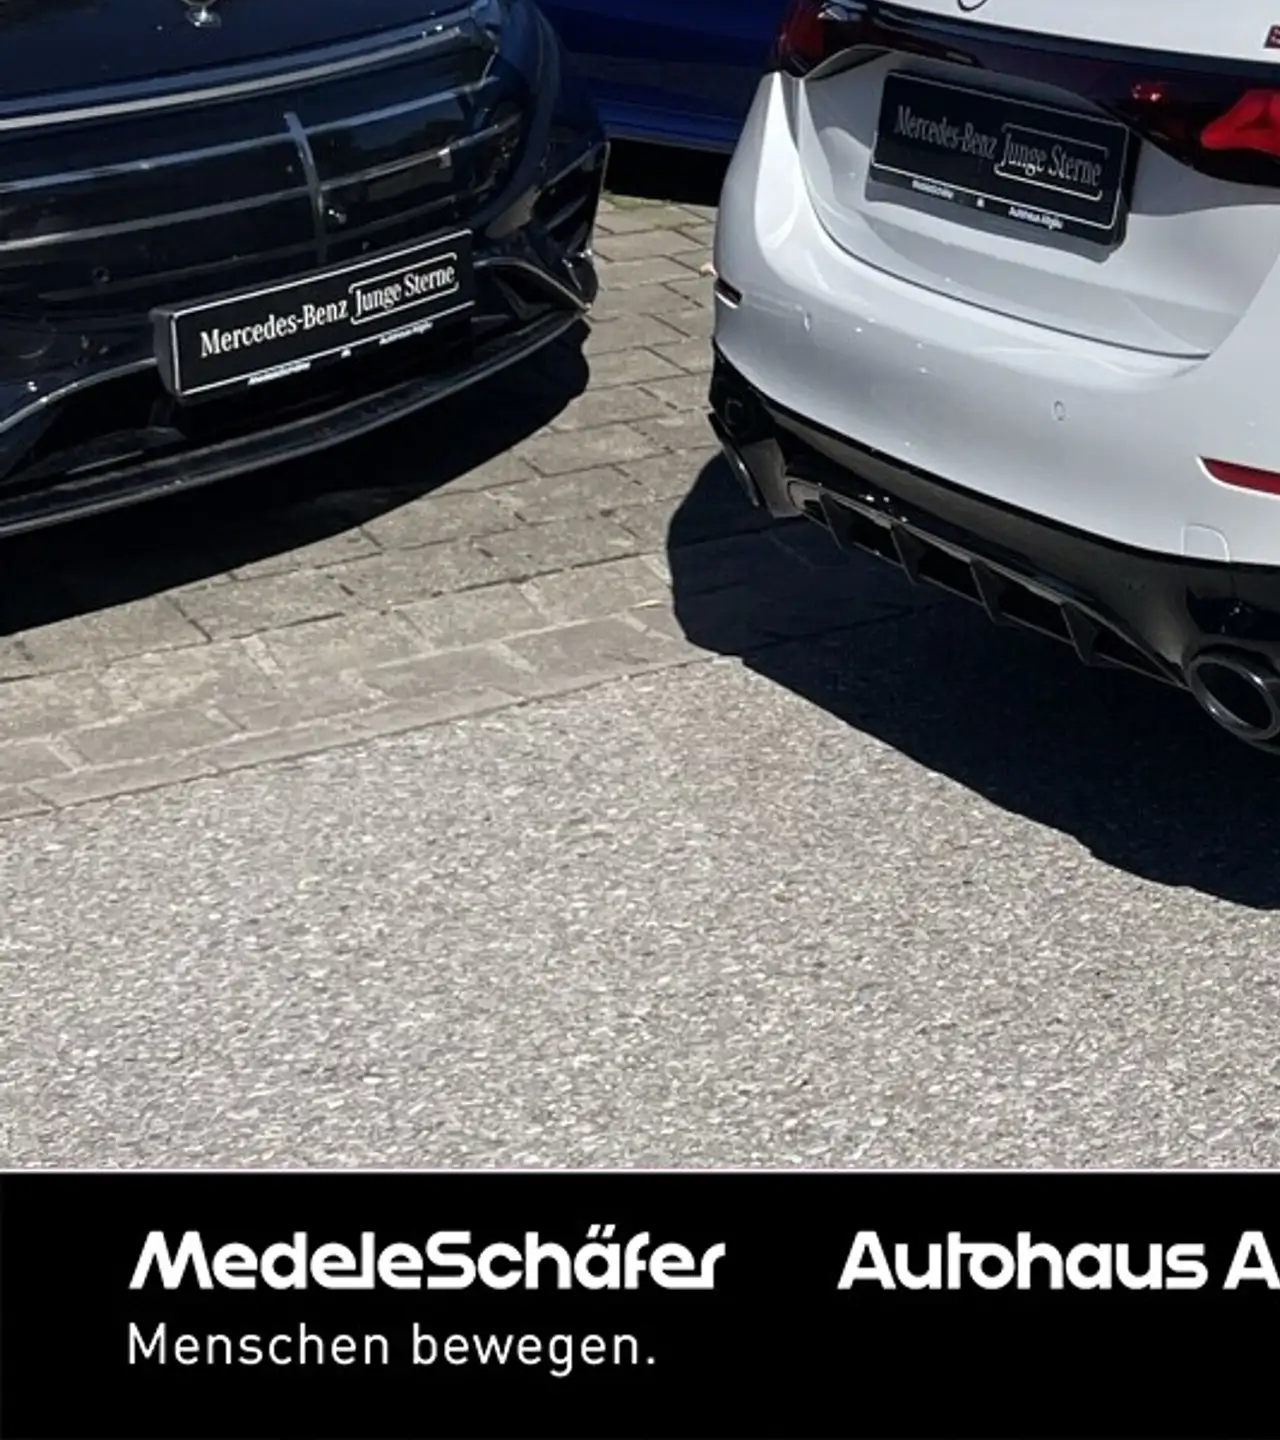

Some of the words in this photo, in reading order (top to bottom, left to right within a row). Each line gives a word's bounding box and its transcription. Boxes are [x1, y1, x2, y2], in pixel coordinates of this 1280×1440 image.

[893, 103, 998, 161] Mercedes-Benz
[999, 133, 1047, 176] Junge
[1047, 143, 1102, 187] Sterne
[199, 299, 349, 358] Mercedes-Benz
[354, 282, 402, 317] Junge
[403, 264, 456, 298] Sterne
